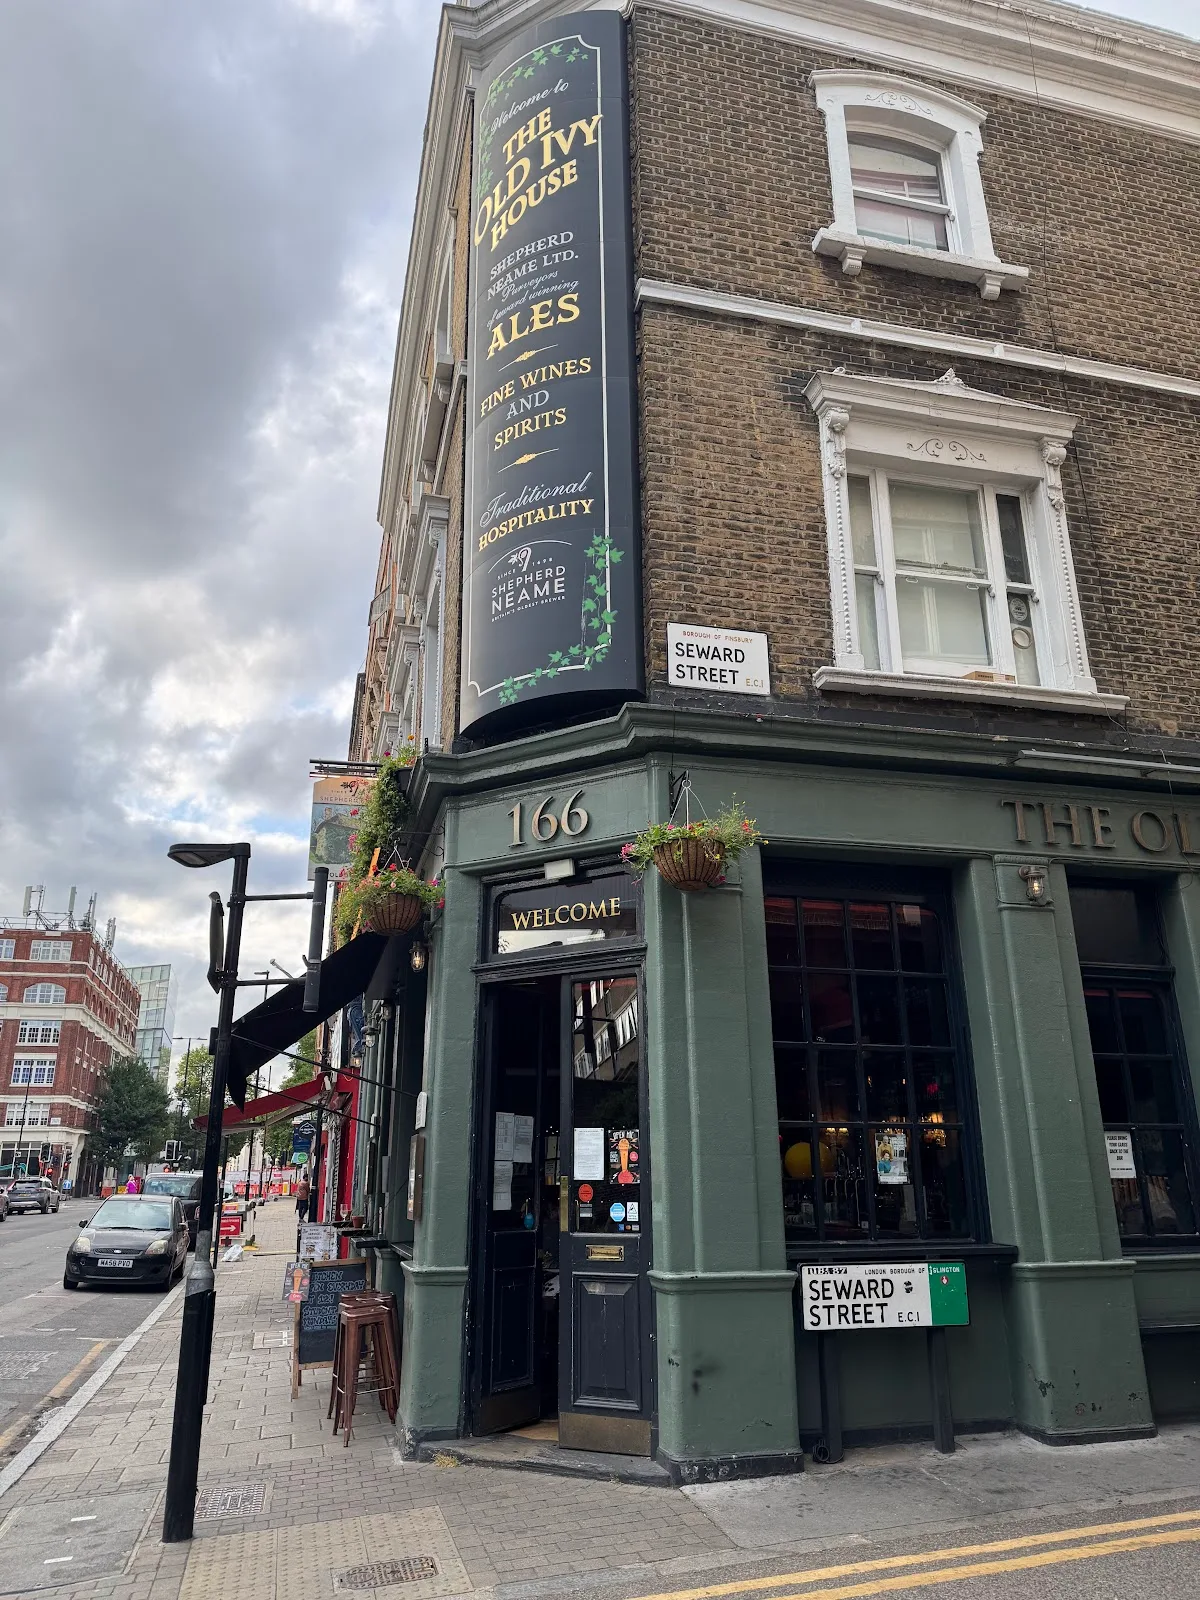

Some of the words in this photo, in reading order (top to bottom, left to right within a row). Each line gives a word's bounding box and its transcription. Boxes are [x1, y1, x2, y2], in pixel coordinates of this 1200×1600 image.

[491, 87, 552, 134] Welcome
[553, 79, 569, 93] to
[502, 107, 552, 164] THE
[474, 157, 531, 247] OLD
[540, 114, 604, 169] IVY
[490, 158, 578, 252] HOUSE
[487, 259, 538, 301] NEAME
[542, 249, 579, 267] LTD.
[489, 231, 574, 281] SHEPHERD
[496, 289, 529, 320] award
[528, 279, 579, 301] winning
[501, 270, 558, 302] Purveyors
[486, 292, 580, 361] ALES
[480, 379, 515, 418] FINE
[519, 357, 592, 390] WINES
[505, 389, 550, 420] AND
[493, 407, 567, 451] SPIRITS
[480, 471, 592, 528] Traditional
[478, 498, 594, 552] HOSPITALITY
[491, 565, 566, 598] SHEPHERD
[497, 568, 516, 580] SINCE
[491, 577, 565, 615] NEAME
[517, 601, 538, 611] OLDEST
[541, 595, 565, 605] BREWER
[675, 642, 745, 664] SEWARD
[682, 630, 711, 639] BOROUGH
[725, 635, 753, 643] FINSBURY
[675, 663, 739, 685] STREET
[507, 789, 589, 848] 166
[1001, 799, 1117, 849] THE
[1131, 811, 1200, 856] OL
[511, 896, 621, 931] WELCOME
[808, 1278, 894, 1301] SEWARD
[890, 1267, 916, 1275] BOROUGH
[928, 1264, 961, 1276] ISLINGTON
[809, 1302, 889, 1327] STREET
